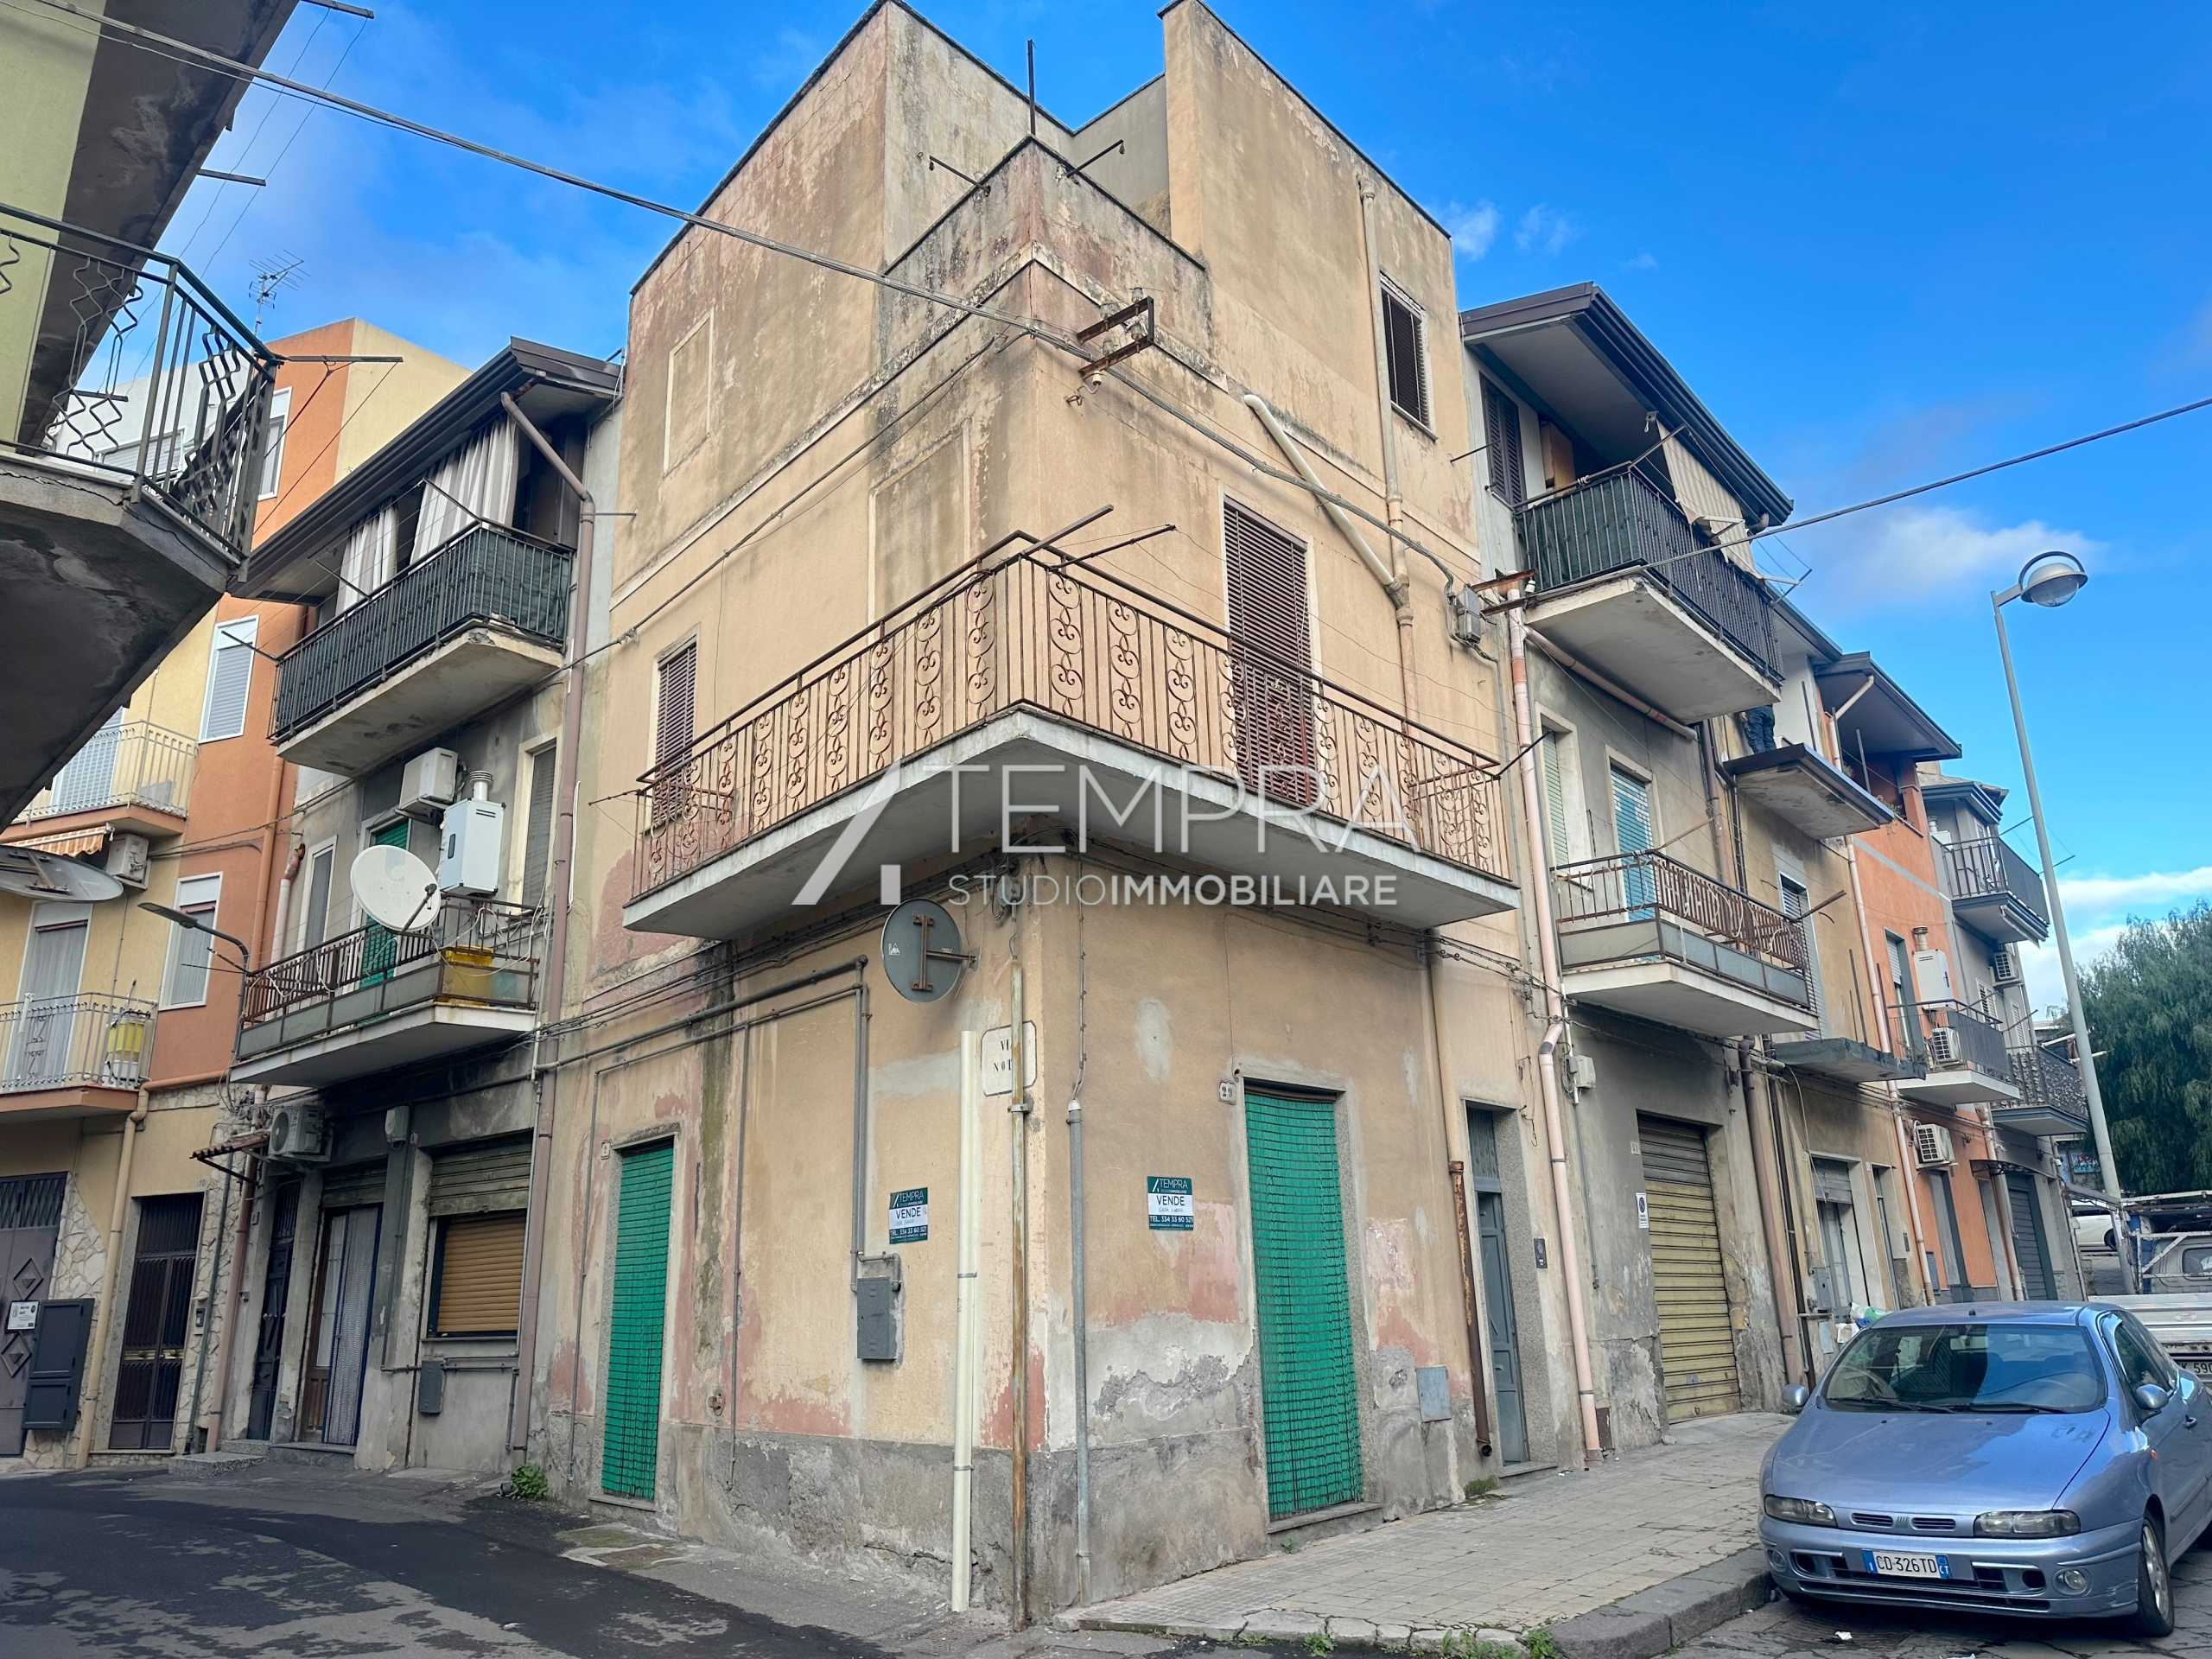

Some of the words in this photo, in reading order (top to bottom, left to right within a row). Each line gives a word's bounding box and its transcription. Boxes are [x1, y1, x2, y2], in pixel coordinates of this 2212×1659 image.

[1000, 1039, 1012, 1052] VI
[1159, 1179, 1189, 1190] TEMPRA
[899, 1191, 925, 1202] TEMPRA
[1156, 1195, 1185, 1206] VENDE
[896, 1206, 922, 1219] VENDE
[1939, 1565, 1950, 1575] CT
